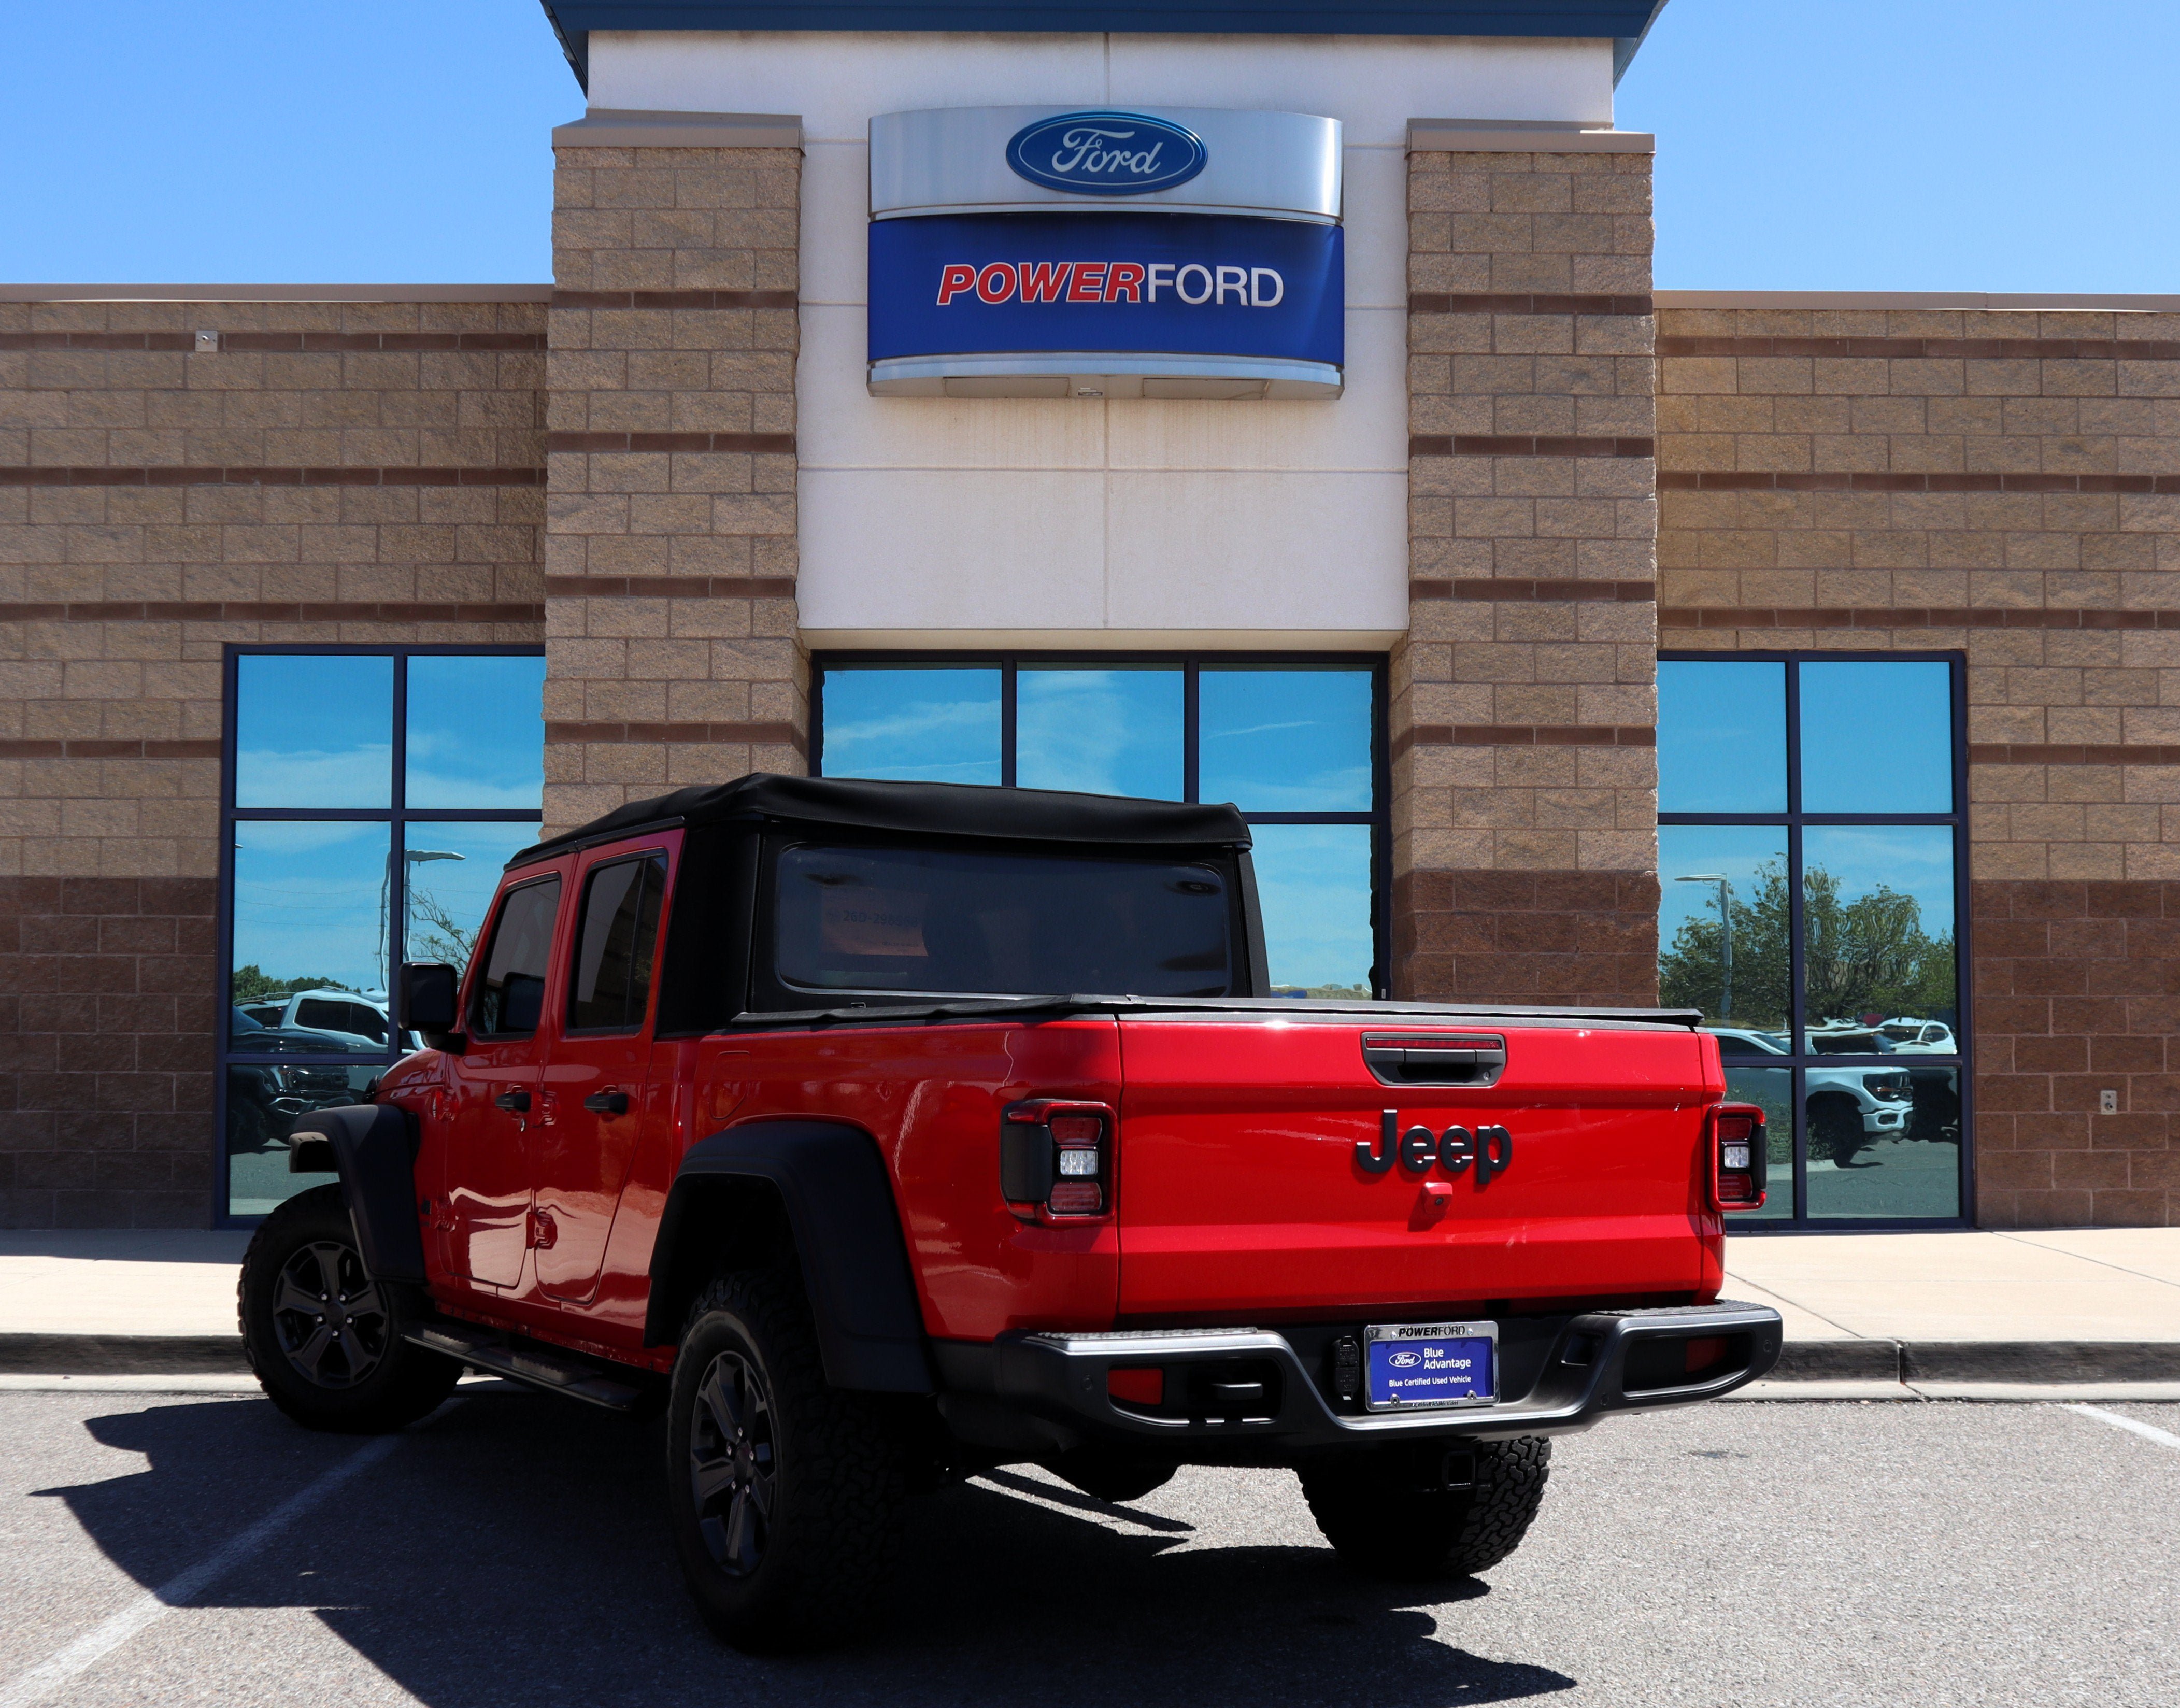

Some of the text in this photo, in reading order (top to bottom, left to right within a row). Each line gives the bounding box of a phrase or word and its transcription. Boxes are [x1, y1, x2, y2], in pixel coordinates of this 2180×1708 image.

[1051, 127, 1164, 174] Ford
[936, 262, 1285, 307] POWERFORD
[1356, 1109, 1512, 1184] Jeep
[1398, 1325, 1465, 1337] POWERFORD
[1423, 1347, 1444, 1358] Blue
[1394, 1354, 1416, 1365] Ford
[1423, 1358, 1471, 1370] Advantage
[1404, 1377, 1431, 1386] Certified
[1432, 1376, 1448, 1385] Used
